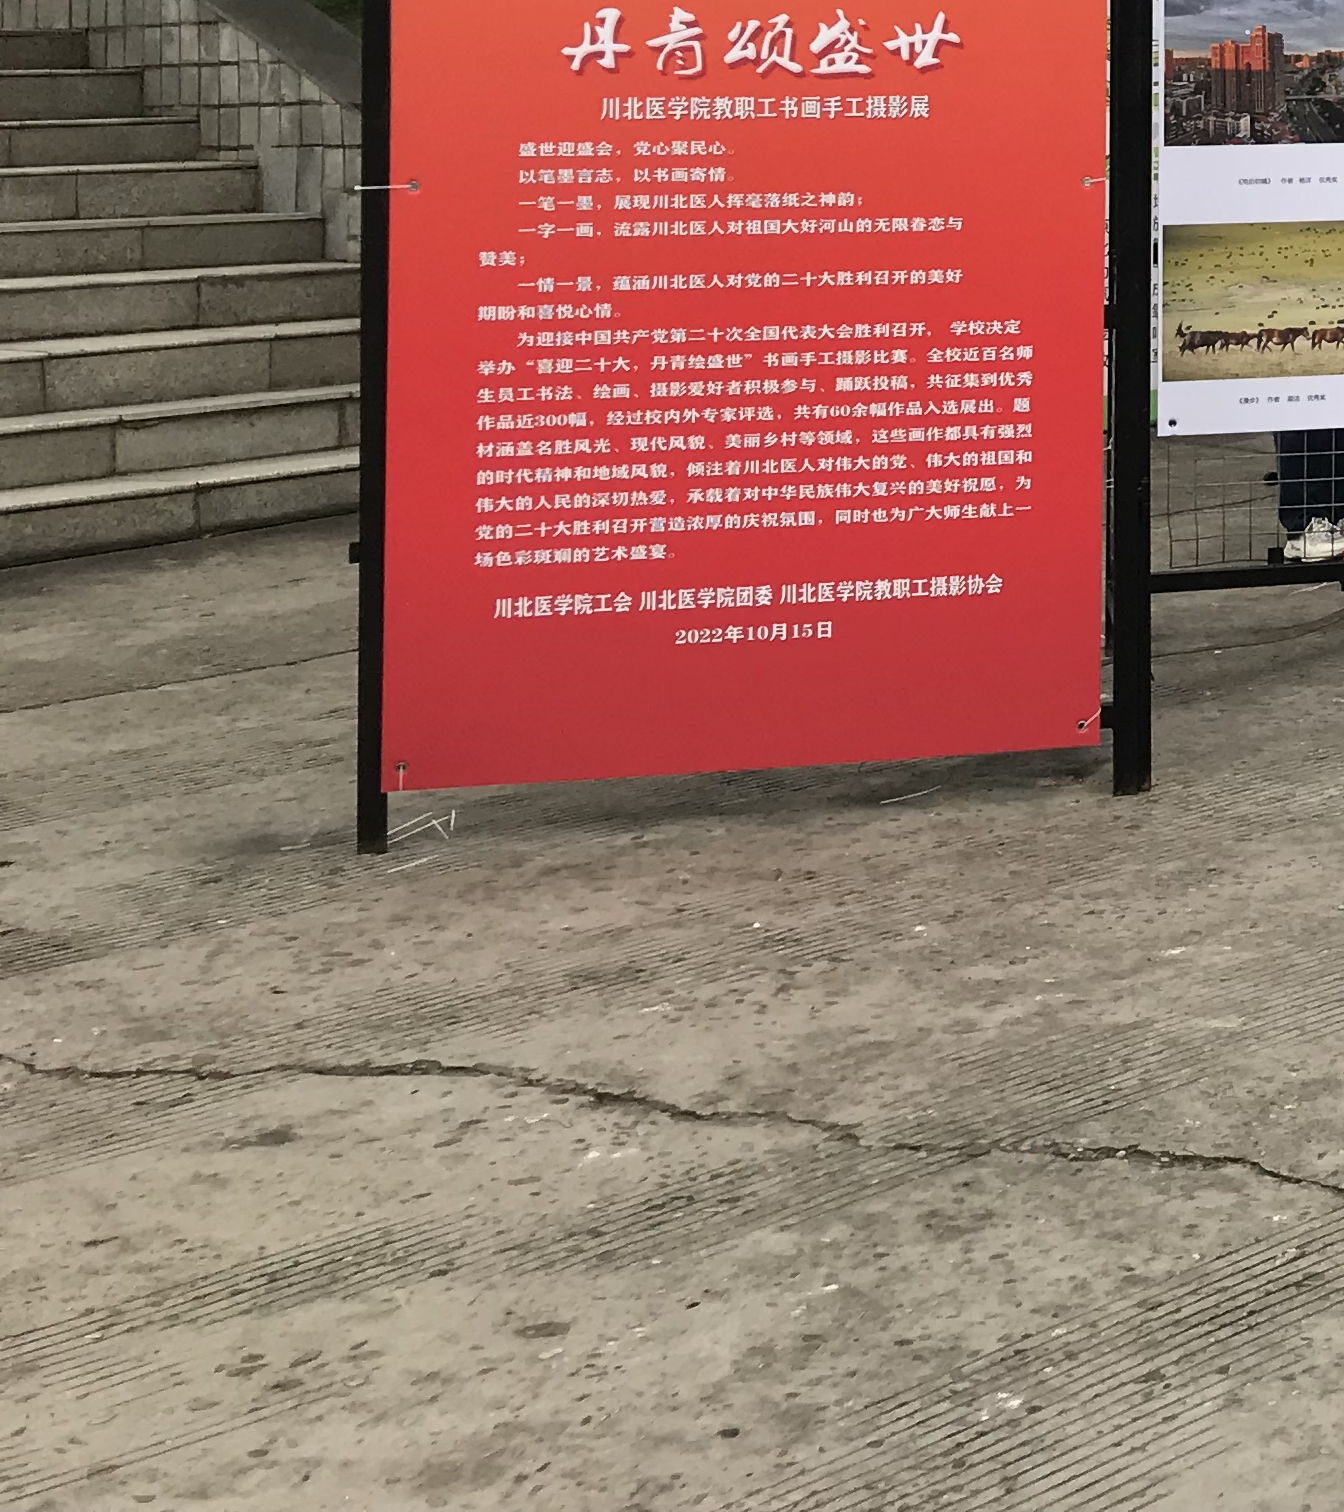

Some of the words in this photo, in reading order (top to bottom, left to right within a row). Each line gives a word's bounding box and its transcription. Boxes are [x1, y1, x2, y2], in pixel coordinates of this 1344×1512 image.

[560, 8, 962, 78] 丹青颂盛世
[600, 94, 930, 121] 川北医学院教职工书画手工摄影展
[518, 140, 736, 157] 盛世迎盛会，党心聚民心。
[518, 166, 736, 185] 以笔墨言志，以书画寄情。
[518, 191, 864, 212] 一笔一墨，展现川北医人挥毫落纸之神韵；
[517, 216, 964, 239] 一字一画，流露川北医人对祖国大好河山的无限眷恋与
[478, 250, 527, 267] 赞美；
[477, 302, 623, 322] 期盼和喜悦心情。
[476, 370, 1033, 404] 生员工书法、绘画、摄影爱好者积极参与、踊跃投稿，共征集到优秀
[475, 422, 1033, 459] 材涵盖名胜风光、现代风貌、美丽乡村等领域，这些画作都具有强烈
[476, 449, 1033, 486] 的时代精神和地域风貌，倾注着川北医人对伟大的党、伟大的祖国和
[474, 475, 1032, 514] 伟大的人民的深切热爱，承载着对中华民族伟大复兴的美好祝愿，为
[474, 502, 1032, 541] 党的二十大胜利召开营造浓厚的庆祝氛围，同时也为广大师生献上一
[473, 543, 677, 568] 场色彩斑斓的艺术盛宴。
[493, 592, 633, 619] 川北医学院工会
[638, 584, 774, 612] 川北医学院团委
[778, 573, 1003, 606] 川北医学院教职工摄影协会
[674, 620, 833, 645] 2022年10月15日
